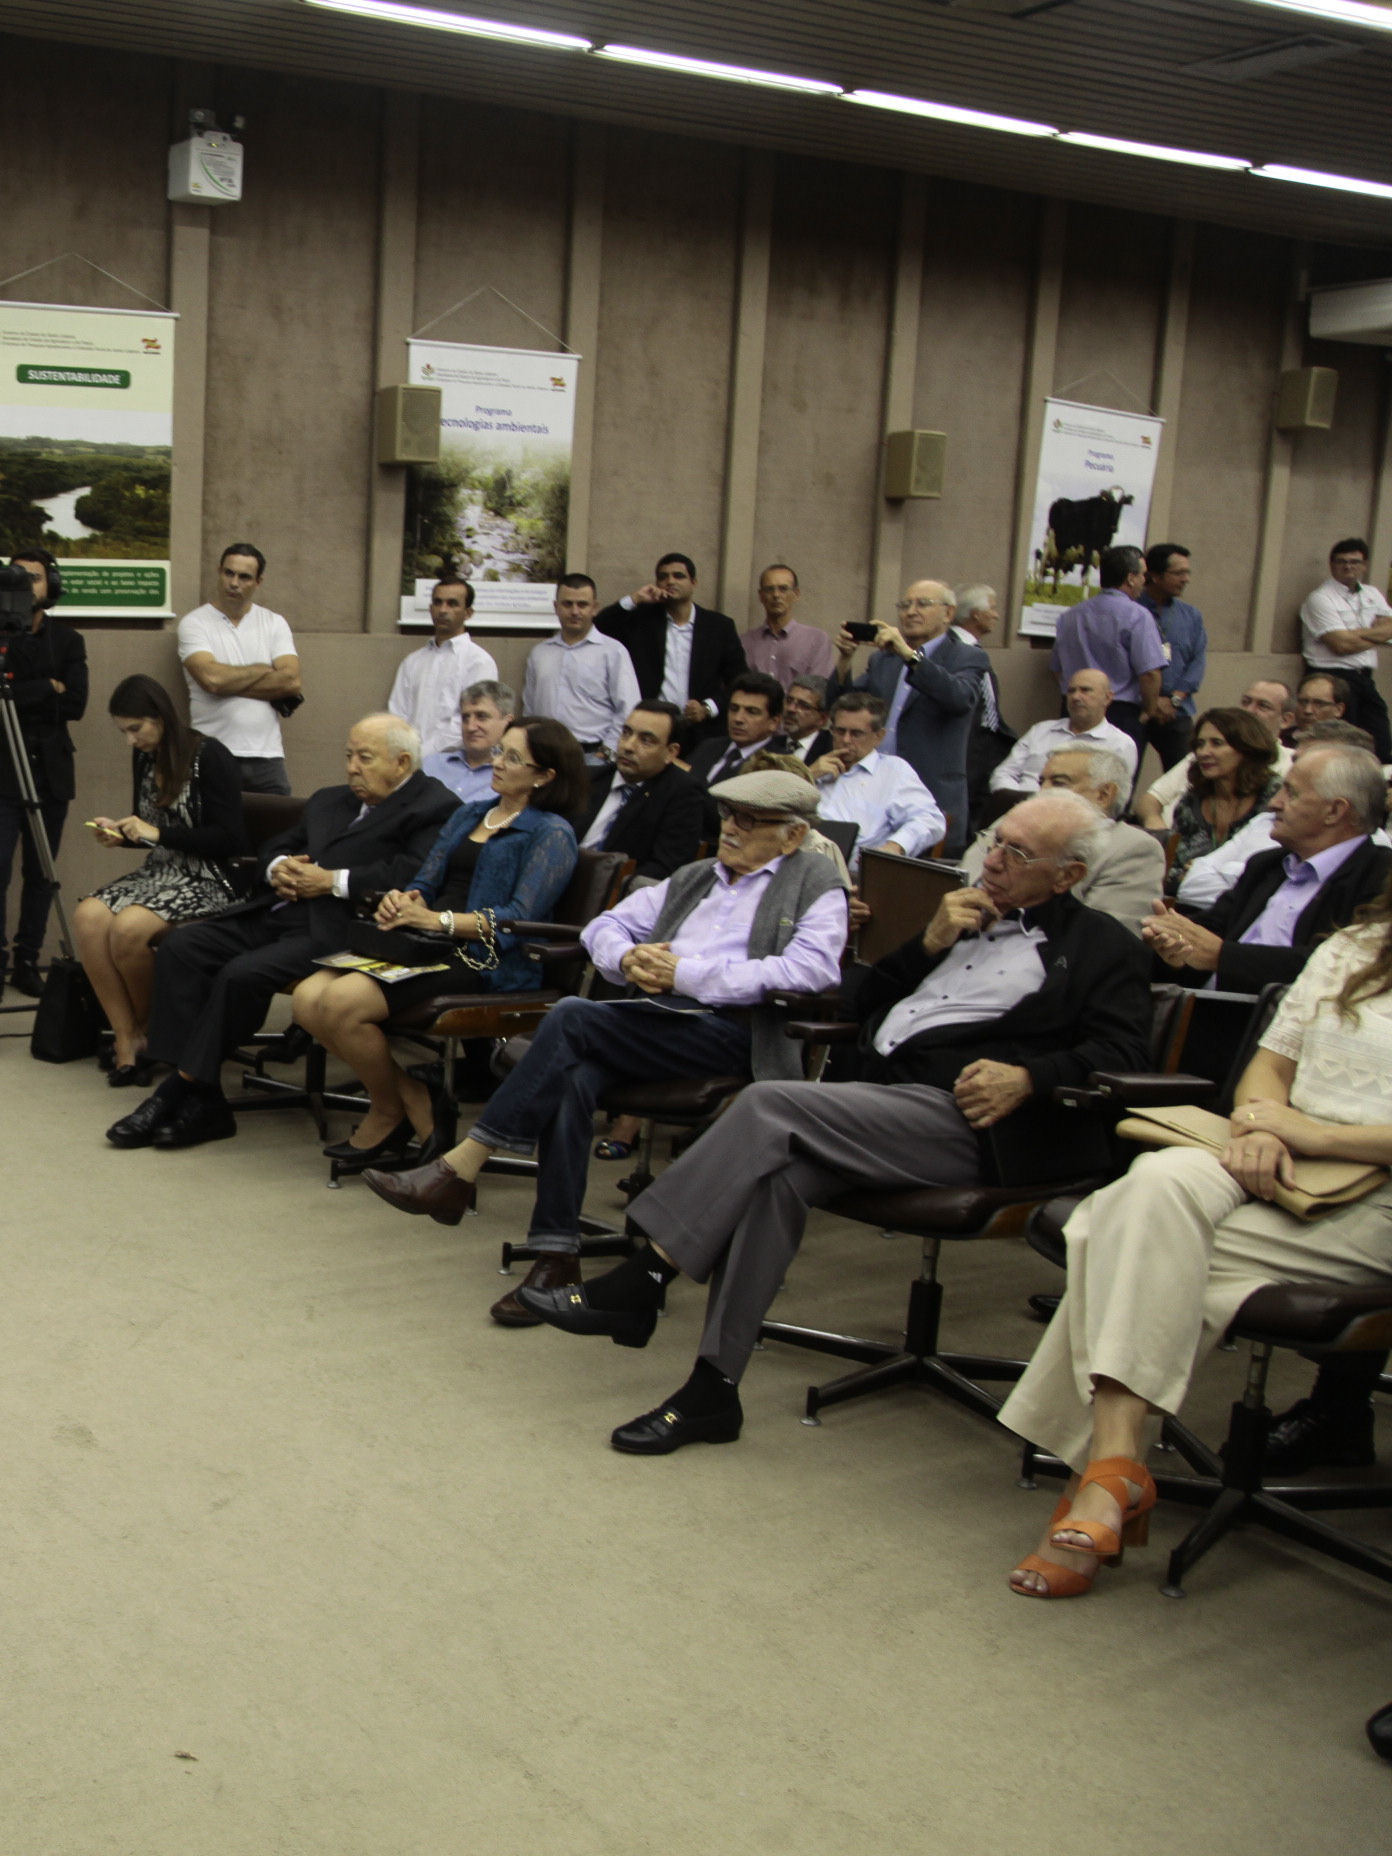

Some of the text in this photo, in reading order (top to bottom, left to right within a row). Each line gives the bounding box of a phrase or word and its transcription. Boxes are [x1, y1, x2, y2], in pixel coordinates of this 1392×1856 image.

[27, 369, 122, 385] SUSTENTABILIDADE
[475, 405, 512, 417] Programa
[440, 417, 550, 435] ecnologias ambientais
